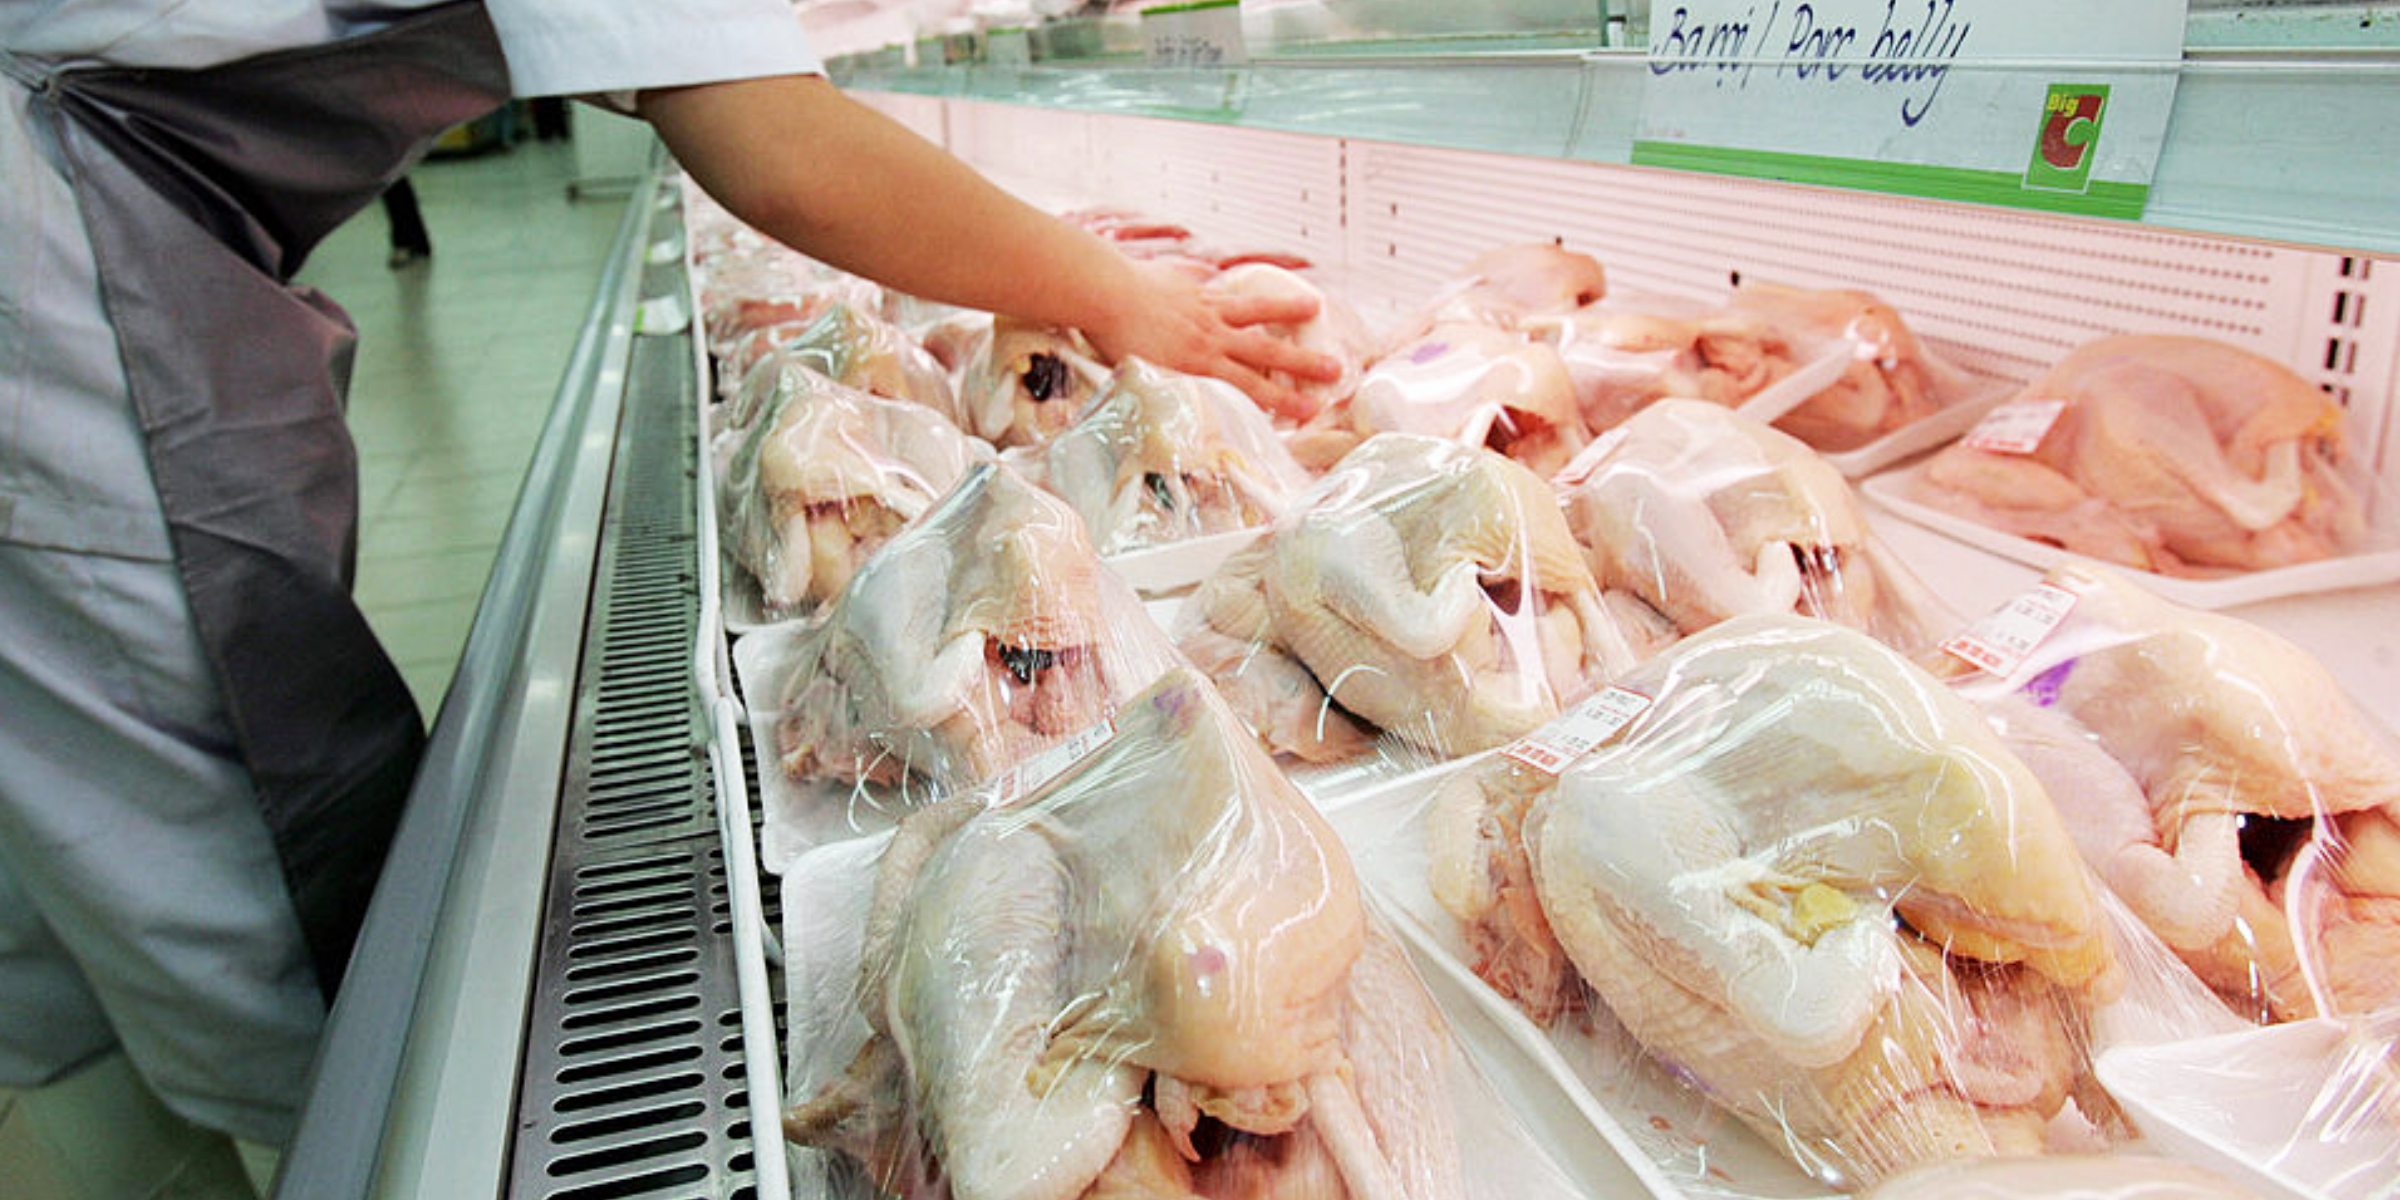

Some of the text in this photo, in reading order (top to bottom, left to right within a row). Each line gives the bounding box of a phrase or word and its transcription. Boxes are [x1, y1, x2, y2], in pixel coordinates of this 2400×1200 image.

[1862, 0, 1970, 127] belly
[2041, 93, 2104, 169] Big C
